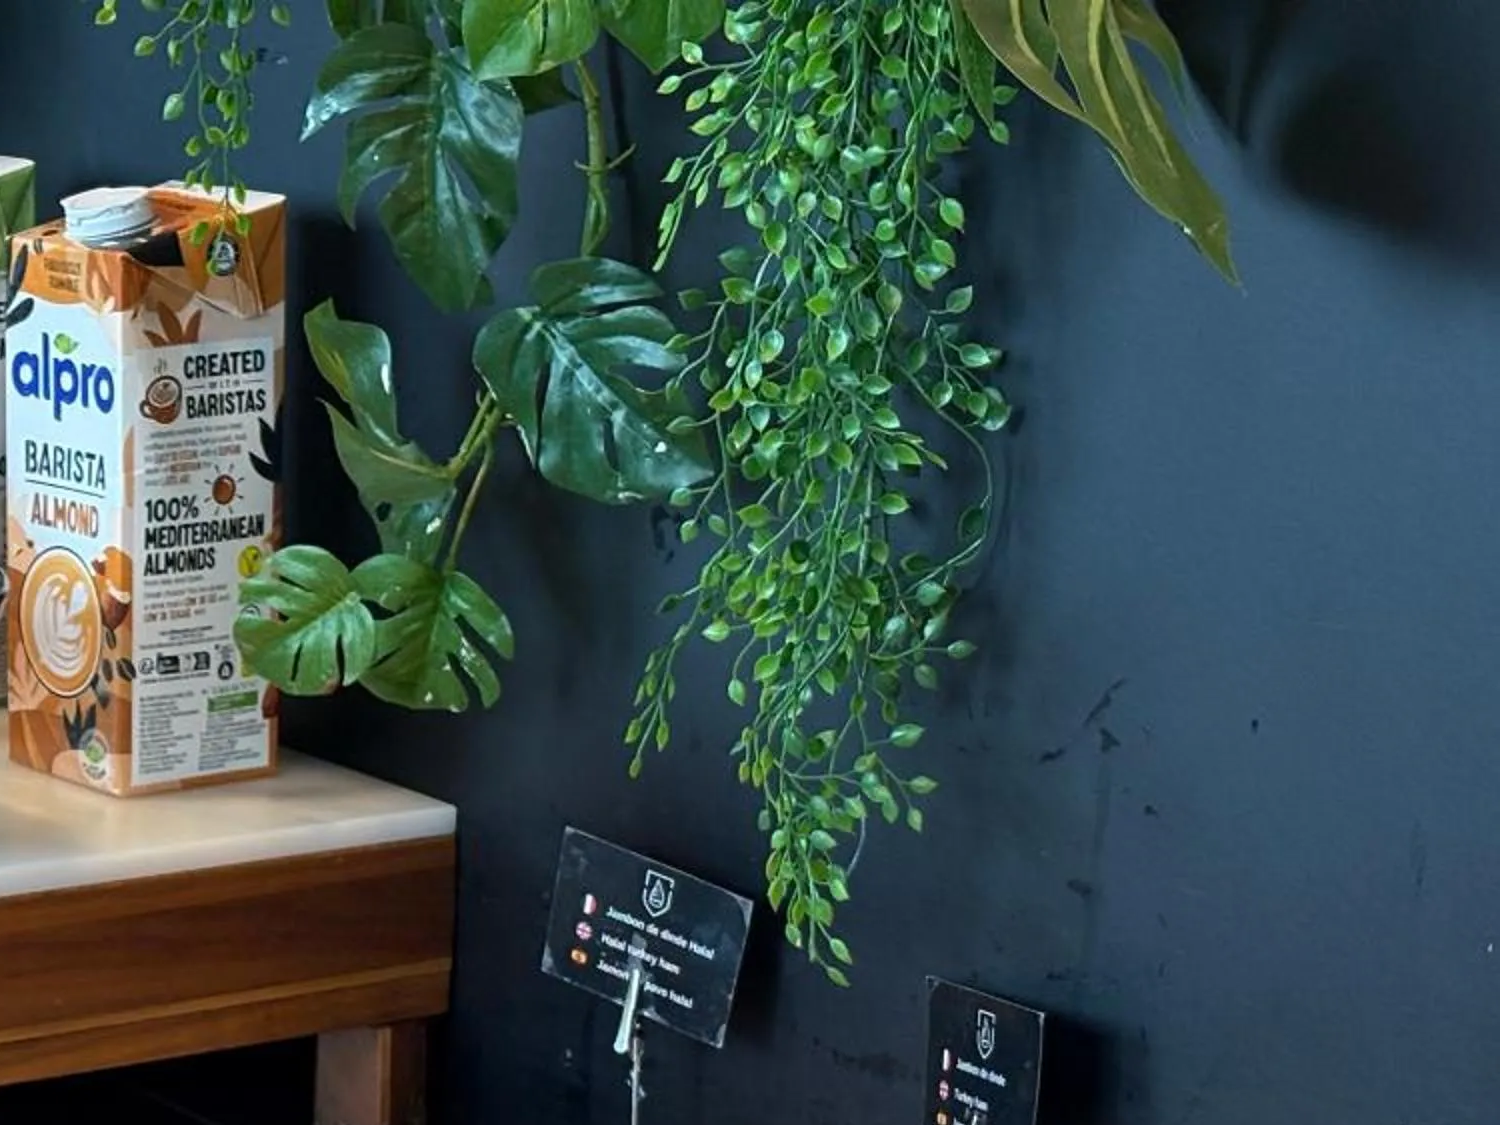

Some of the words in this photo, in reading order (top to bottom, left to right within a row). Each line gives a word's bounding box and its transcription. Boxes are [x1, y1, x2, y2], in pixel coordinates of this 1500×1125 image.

[11, 332, 115, 422] alpro
[183, 349, 266, 380] CREATED
[185, 387, 267, 419] BARISTAS
[25, 439, 107, 490] BARISTA
[30, 492, 100, 539] ALMOND
[144, 494, 199, 523] 100%
[144, 513, 265, 550] MEDITERRANEAN
[144, 546, 215, 577] ALMONDS
